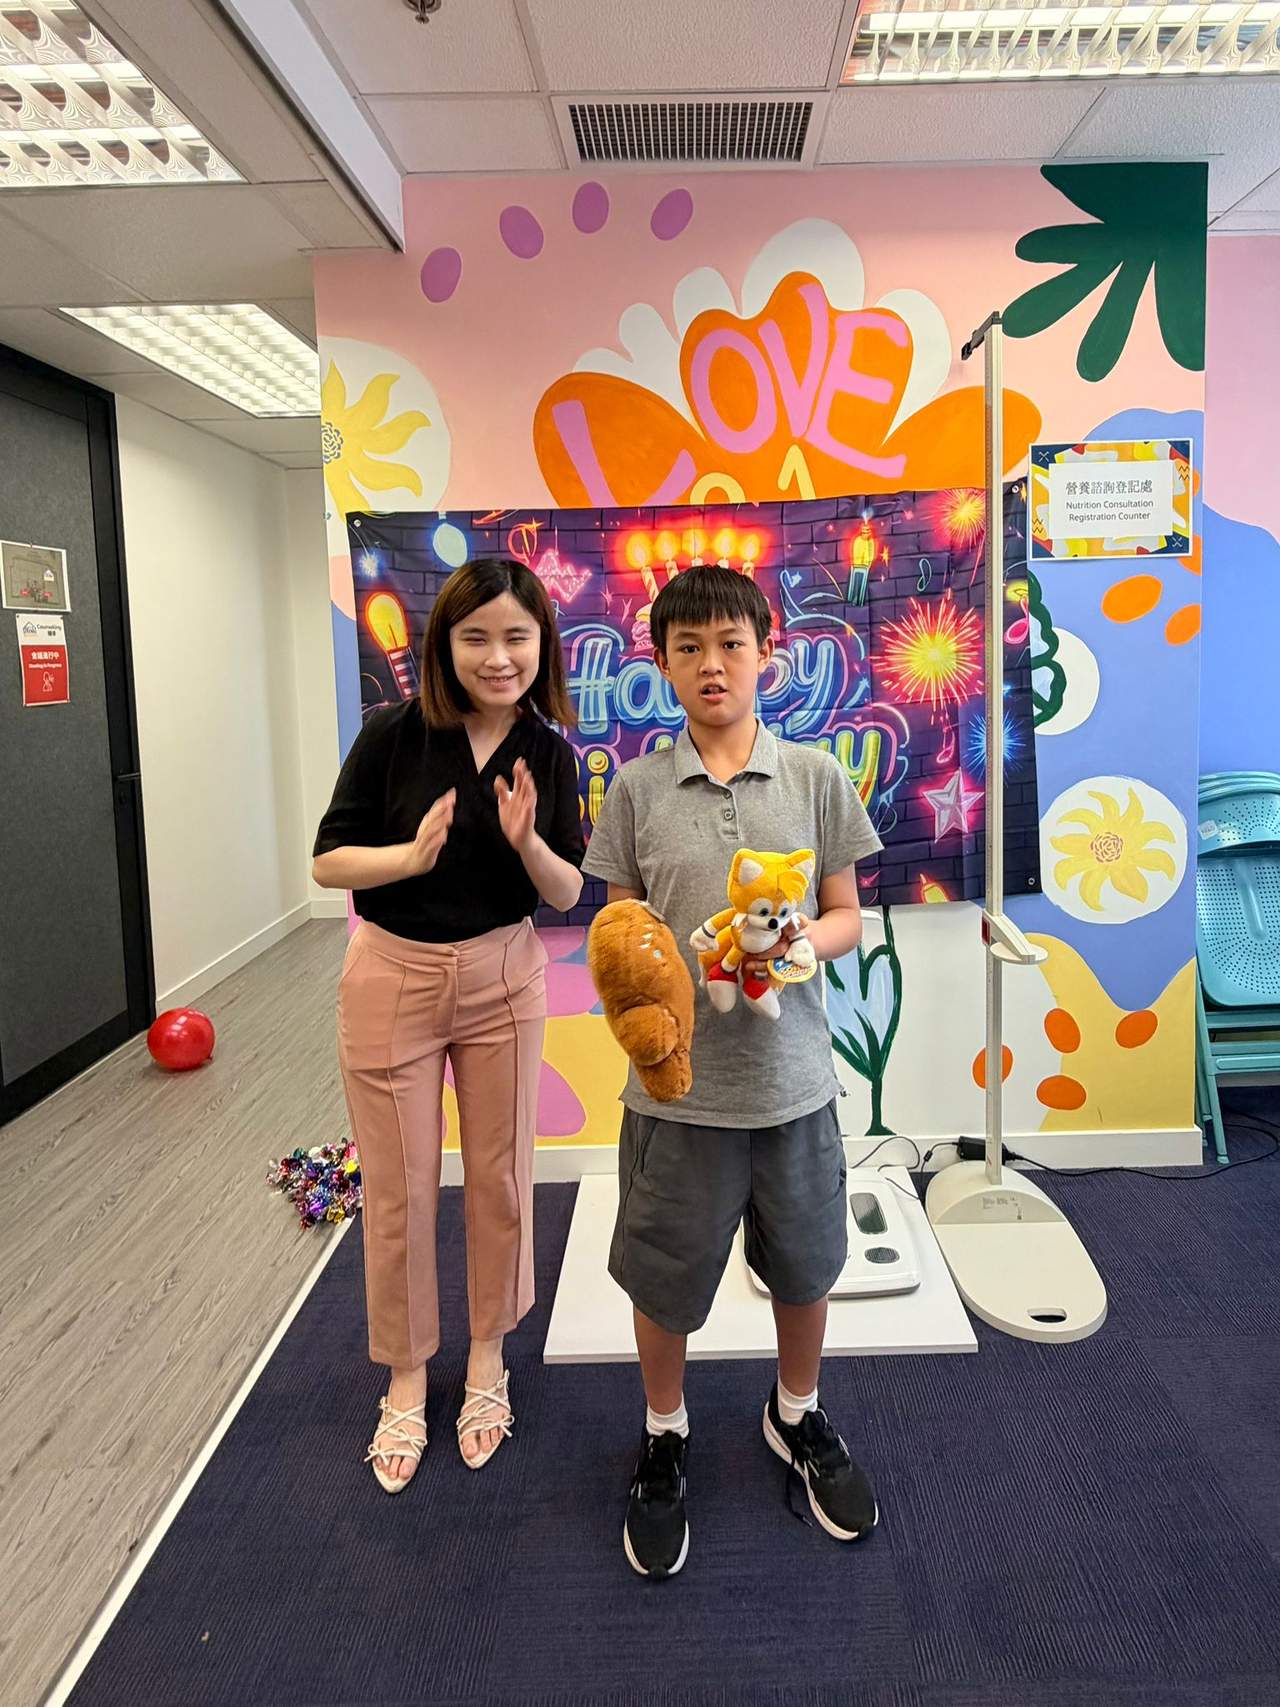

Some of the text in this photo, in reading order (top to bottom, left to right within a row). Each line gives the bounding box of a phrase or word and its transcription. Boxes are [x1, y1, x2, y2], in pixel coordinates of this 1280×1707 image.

[552, 283, 908, 507] LOVE
[1066, 479, 1153, 495] 營養諮詢登記處
[1066, 500, 1153, 510] Nutrition Consultation
[1069, 512, 1151, 522] Registration Counter
